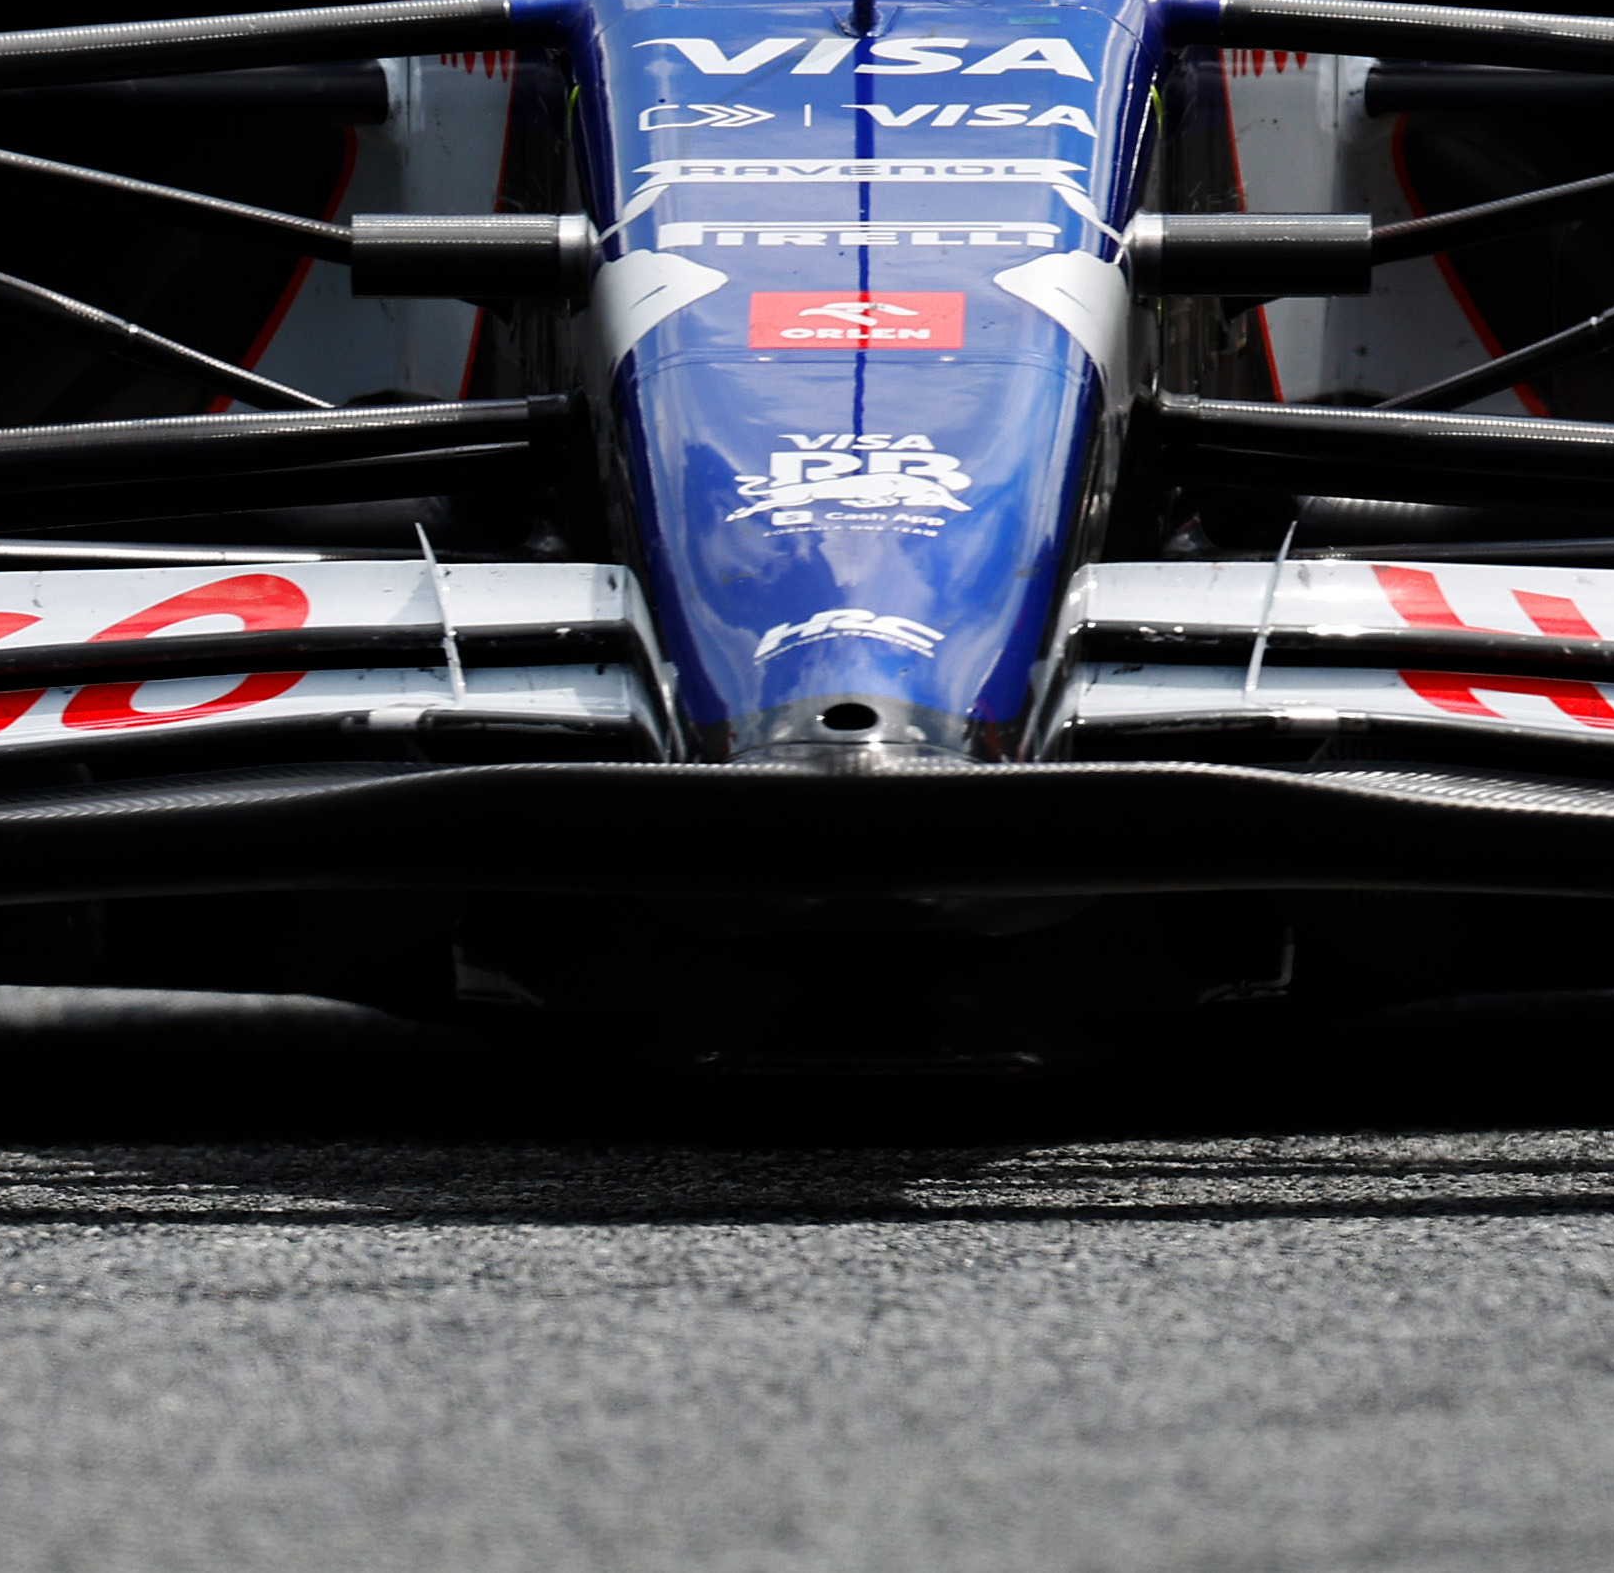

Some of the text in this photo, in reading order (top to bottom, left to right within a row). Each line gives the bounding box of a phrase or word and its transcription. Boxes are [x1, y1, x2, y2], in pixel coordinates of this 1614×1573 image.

[632, 38, 1094, 82] VISA
[841, 104, 1098, 139] VISA
[658, 222, 1061, 249] PIRELLI
[780, 327, 930, 340] ORLEN
[777, 434, 935, 450] VISA
